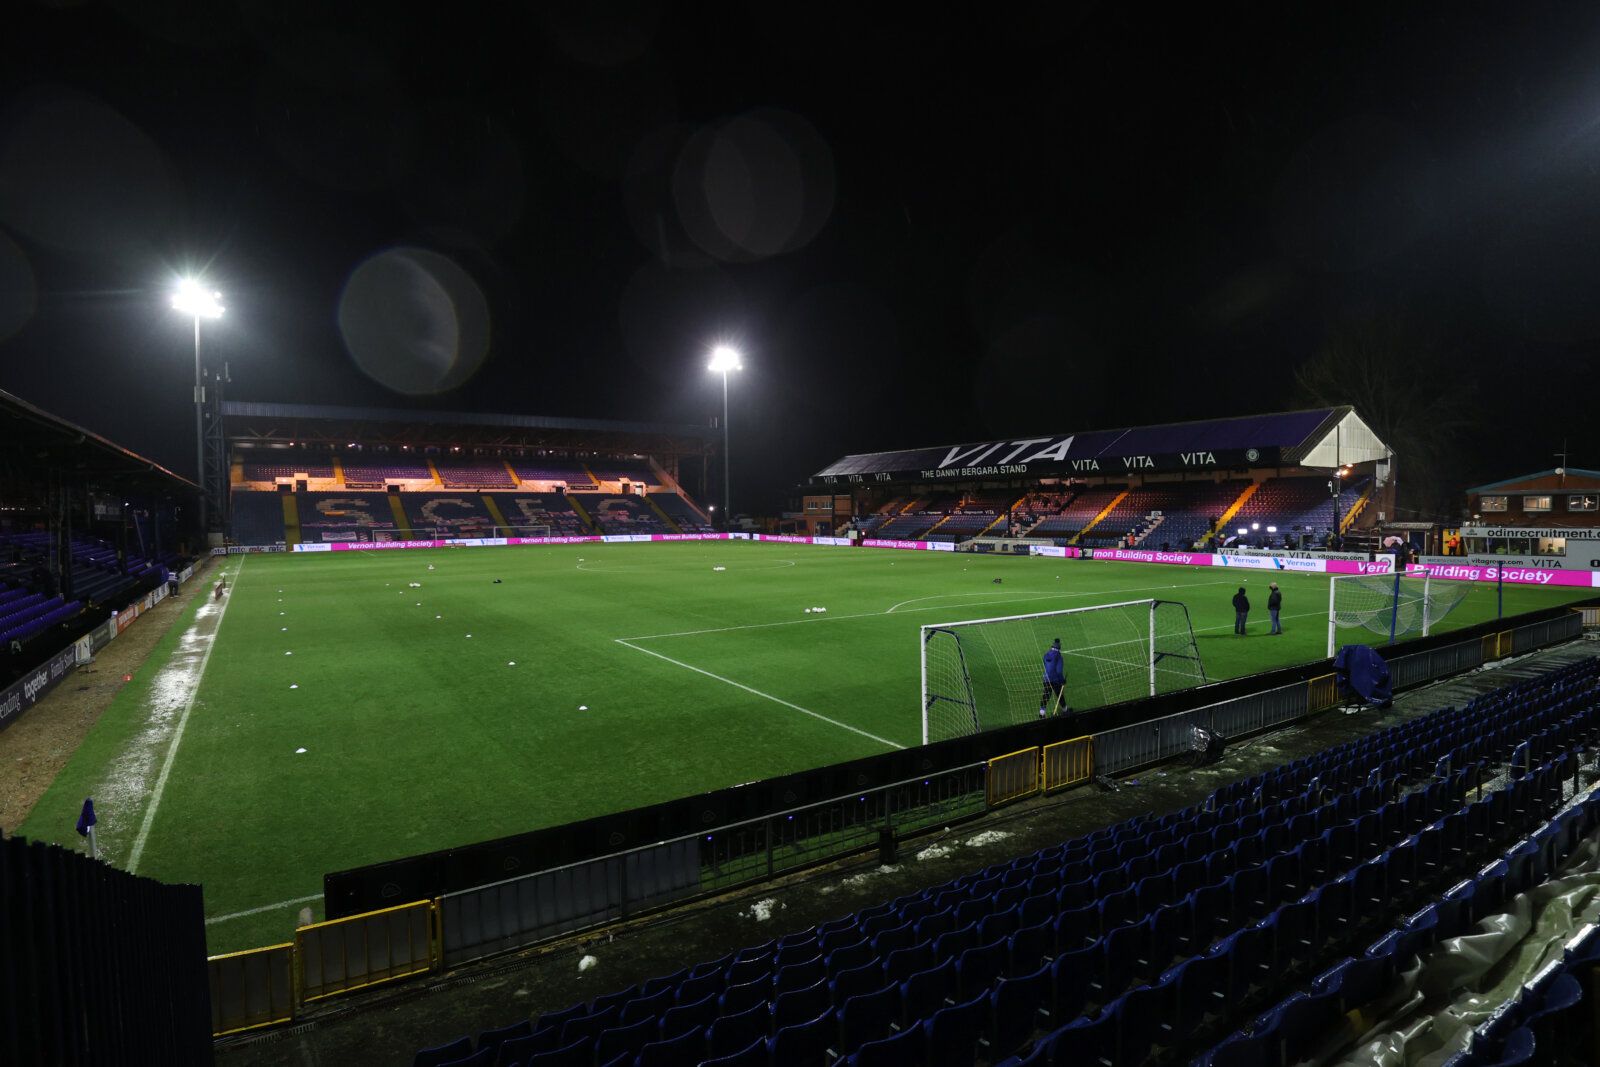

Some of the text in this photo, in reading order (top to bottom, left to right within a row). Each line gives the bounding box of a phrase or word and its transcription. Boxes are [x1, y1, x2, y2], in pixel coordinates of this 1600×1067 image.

[937, 435, 1075, 469] VITA
[1122, 456, 1154, 468] VITA
[1180, 452, 1217, 465] VITA
[1072, 459, 1099, 471] VITA
[874, 472, 892, 481] VITA
[921, 463, 1027, 479] THE DANNY BERGARA STAND
[823, 476, 838, 484] VITA
[848, 474, 863, 483] VITA
[376, 541, 406, 549] Building
[408, 540, 433, 548] Society
[877, 540, 897, 548] Building
[898, 541, 918, 549] Society
[1116, 550, 1153, 562] Building
[1156, 552, 1192, 564] Society
[1289, 551, 1312, 559] VITA
[1317, 553, 1364, 561] vitagroup.com
[1286, 559, 1316, 567] Vernon
[1531, 559, 1562, 568] VITA
[1412, 565, 1554, 584] Building Society
[24, 671, 48, 703] together
